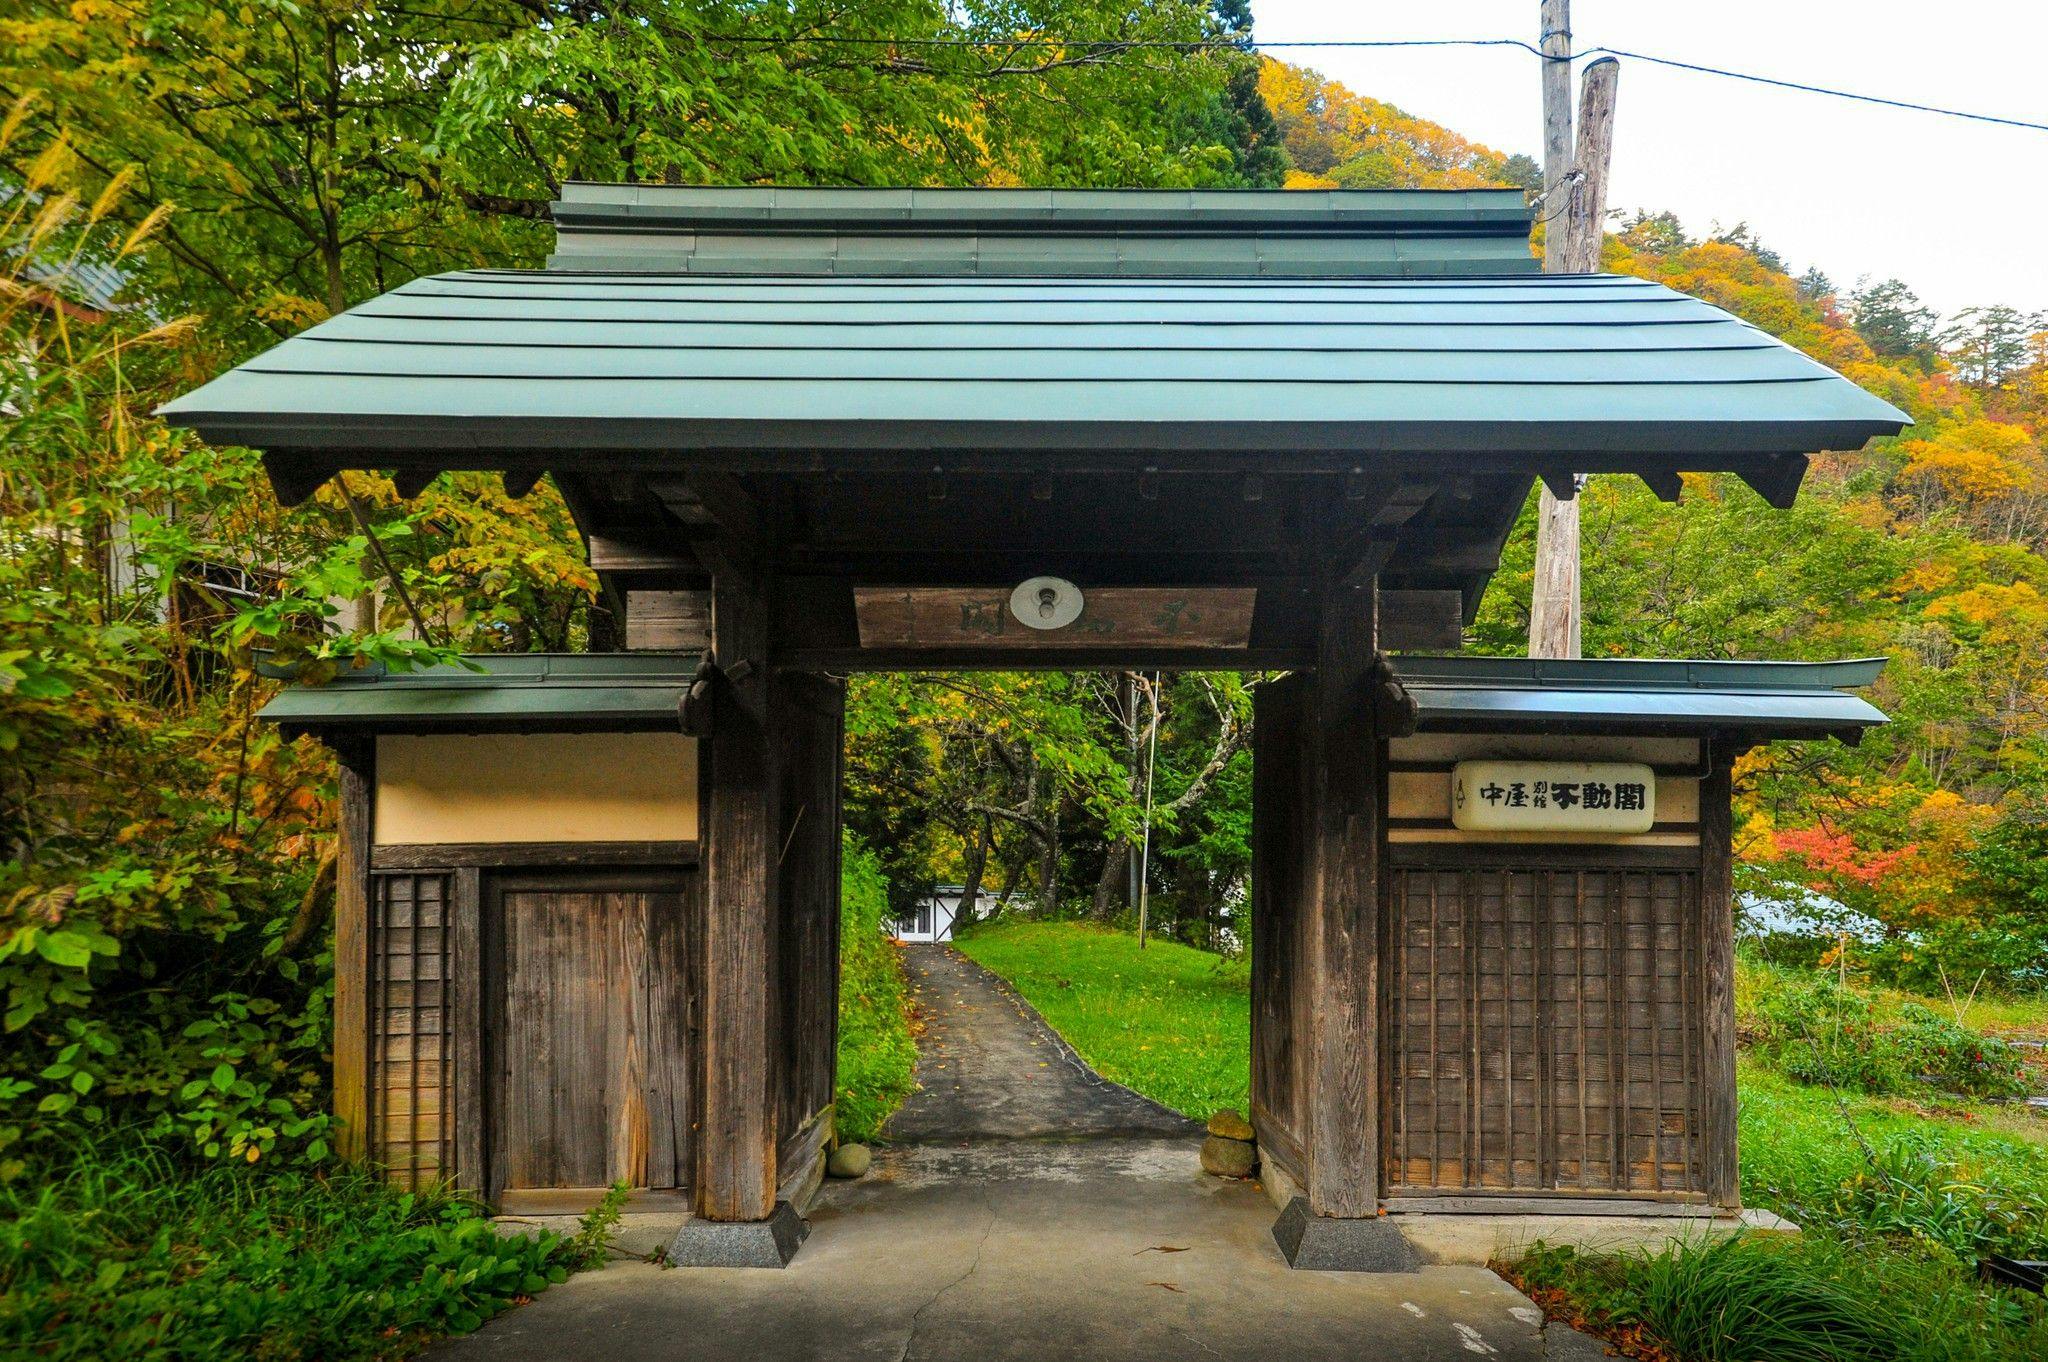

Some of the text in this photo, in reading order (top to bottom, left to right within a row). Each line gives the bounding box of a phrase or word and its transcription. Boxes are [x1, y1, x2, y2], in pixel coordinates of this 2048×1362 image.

[1480, 782, 1529, 808] 中屋
[1551, 781, 1646, 810] 不動閣
